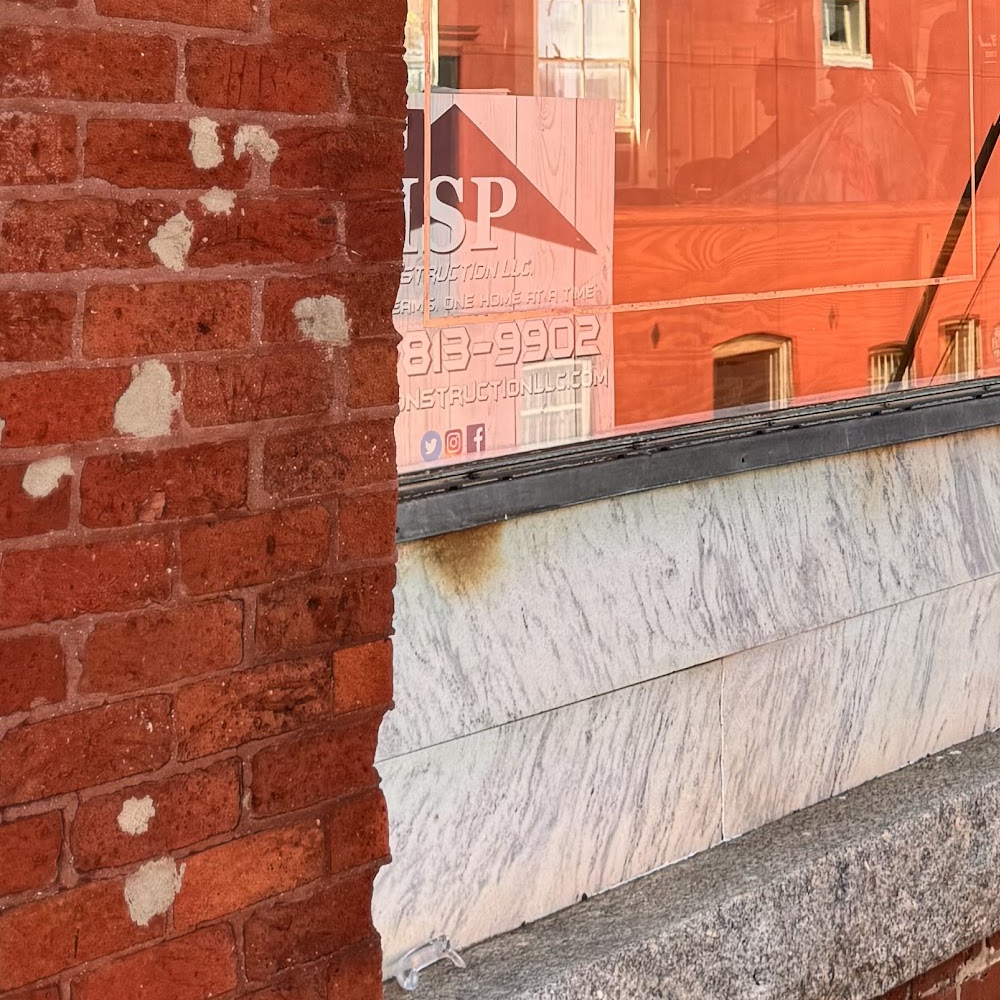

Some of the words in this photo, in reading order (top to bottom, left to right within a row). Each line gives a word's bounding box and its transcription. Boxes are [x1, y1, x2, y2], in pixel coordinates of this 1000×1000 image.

[443, 293, 475, 312] ONE
[479, 289, 522, 309] HOME
[526, 288, 545, 305] AT
[400, 314, 602, 378] 813-9902
